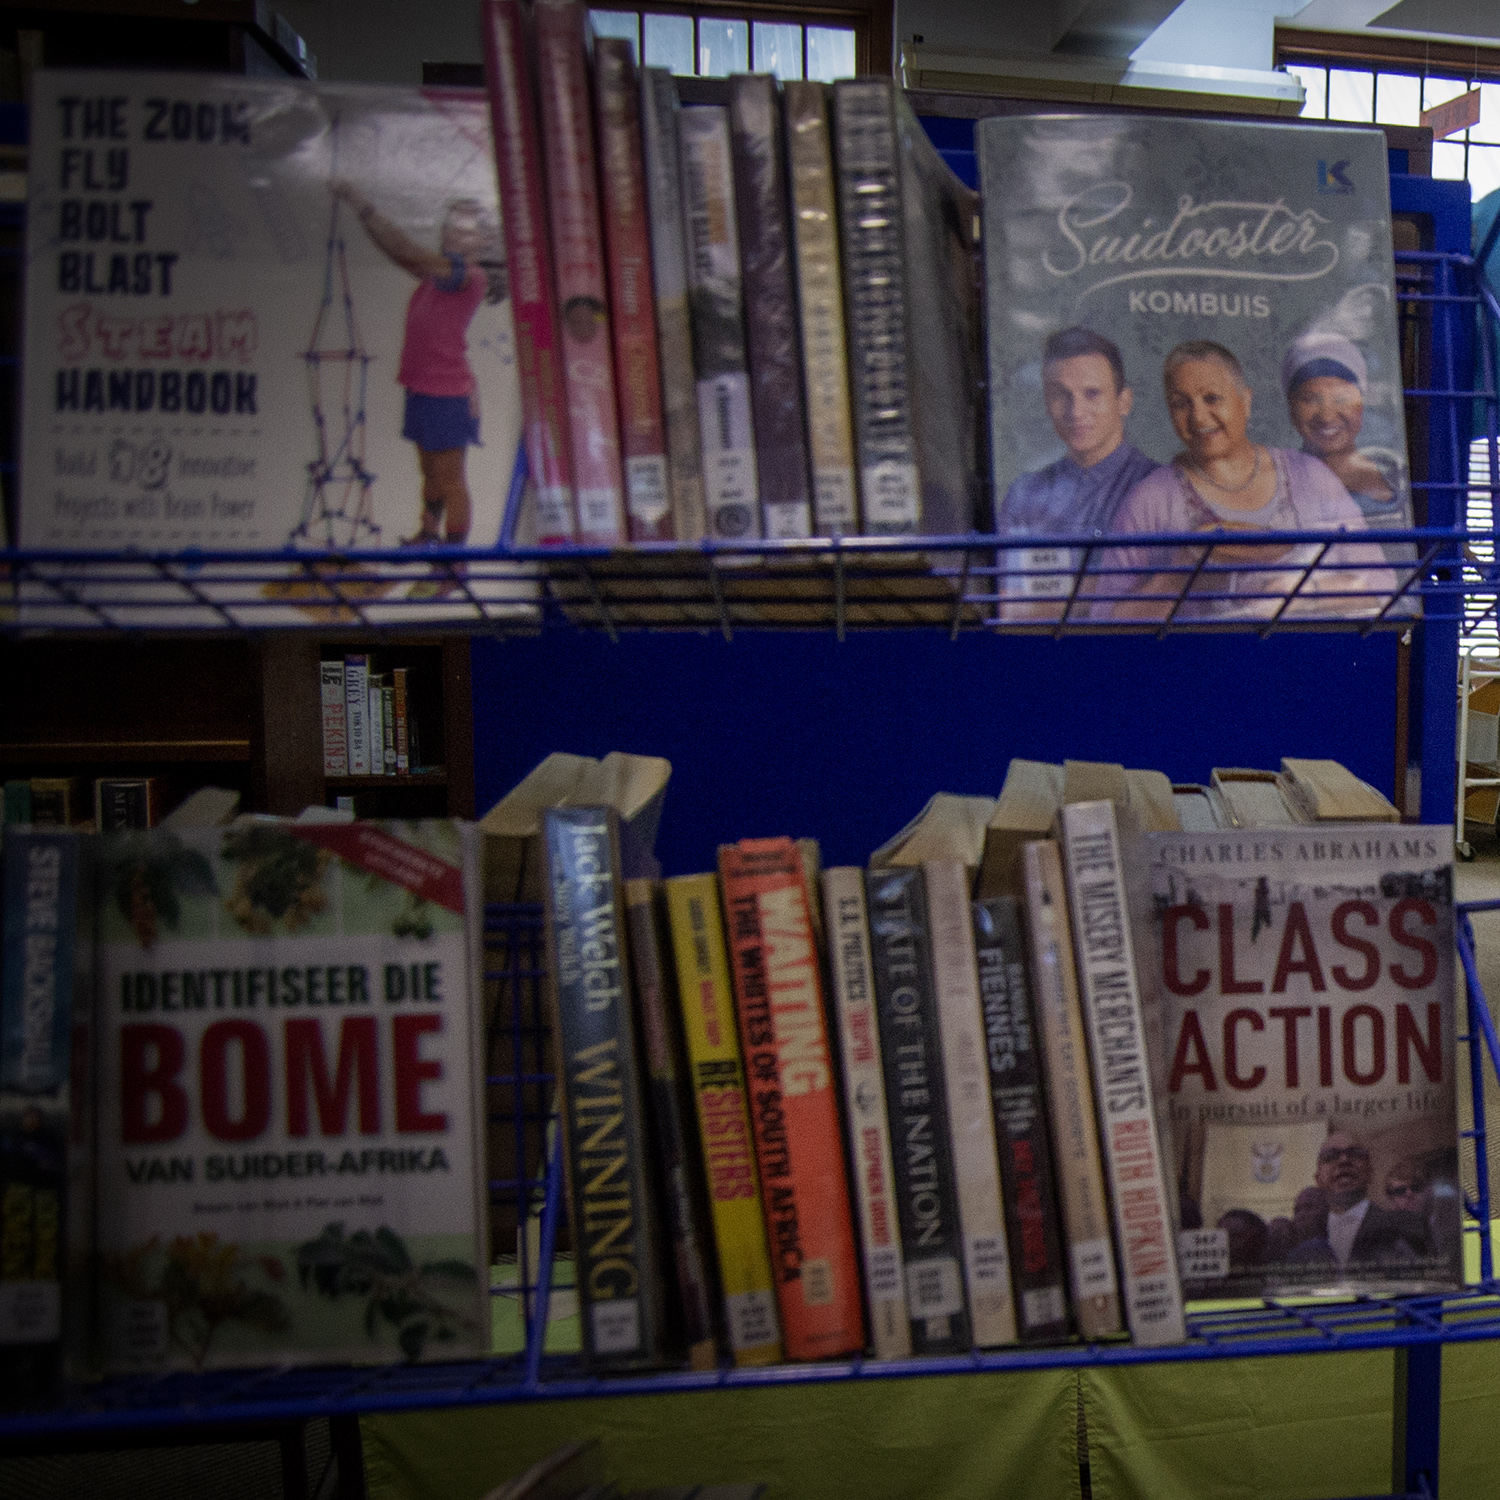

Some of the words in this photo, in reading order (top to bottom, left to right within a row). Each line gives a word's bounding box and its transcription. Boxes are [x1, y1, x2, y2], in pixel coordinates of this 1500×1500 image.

[59, 98, 130, 140] THE
[60, 149, 129, 191] FLY
[59, 200, 154, 243] BOLT
[1042, 181, 1340, 278] Suidooster
[58, 251, 178, 296] BLAST
[1129, 291, 1271, 319] KOMBUIS
[58, 303, 260, 363] STEAM
[56, 368, 259, 415] HANDBOOK
[347, 669, 360, 707] GREY
[572, 822, 611, 896] Jack
[1072, 830, 1115, 872] THE
[1159, 842, 1285, 865] CHARLES
[1298, 838, 1439, 863] ABRAHAMS
[25, 846, 61, 929] STEVE
[731, 892, 762, 945] THE
[1079, 879, 1124, 964] MISERY
[580, 904, 622, 1012] Welch
[880, 887, 914, 974] STATE
[1161, 898, 1440, 997] CLASS
[121, 966, 369, 1011] IDENTIFISEER
[385, 961, 442, 1002] DIE
[738, 948, 777, 1047] WHITES
[757, 885, 830, 1097] WAITING
[890, 986, 922, 1028] OF
[978, 946, 1014, 1072] FIENNES
[751, 1052, 777, 1084] OF
[896, 1039, 930, 1106] THE
[1091, 970, 1146, 1112] MERCHANTS
[1167, 1003, 1444, 1094] ACTION
[119, 1012, 447, 1146] BOME
[1199, 1096, 1278, 1124] pursuit
[1286, 1095, 1310, 1115] of
[1314, 1101, 1326, 1115] a
[1334, 1093, 1399, 1119] larger
[1406, 1091, 1441, 1112] life
[126, 1155, 195, 1185] VAN
[204, 1146, 450, 1182] SUIDER-AFRIKA
[698, 1060, 755, 1201] RESISTERS
[757, 1090, 790, 1179] SOUTH
[1112, 1119, 1154, 1183] RUTH
[574, 1038, 640, 1301] WINNING
[905, 1115, 945, 1247] NATION
[769, 1187, 804, 1284] AFRICA
